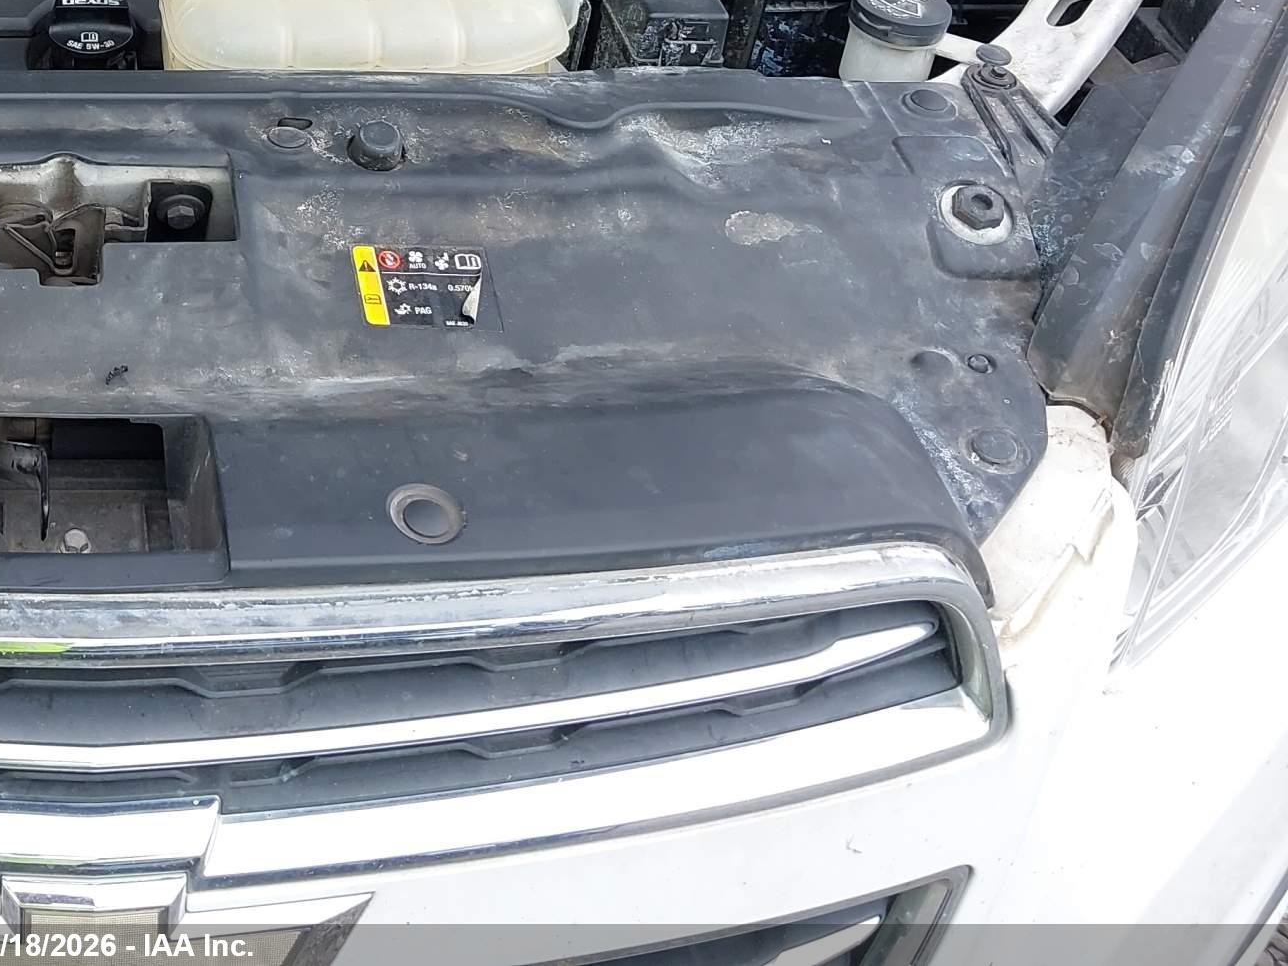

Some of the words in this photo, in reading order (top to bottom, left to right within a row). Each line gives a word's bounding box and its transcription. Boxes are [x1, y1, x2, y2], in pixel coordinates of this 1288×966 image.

[66, 40, 83, 50] SAE
[408, 261, 427, 270] AUTO
[408, 282, 438, 292] R-134a
[414, 306, 432, 315] PAG
